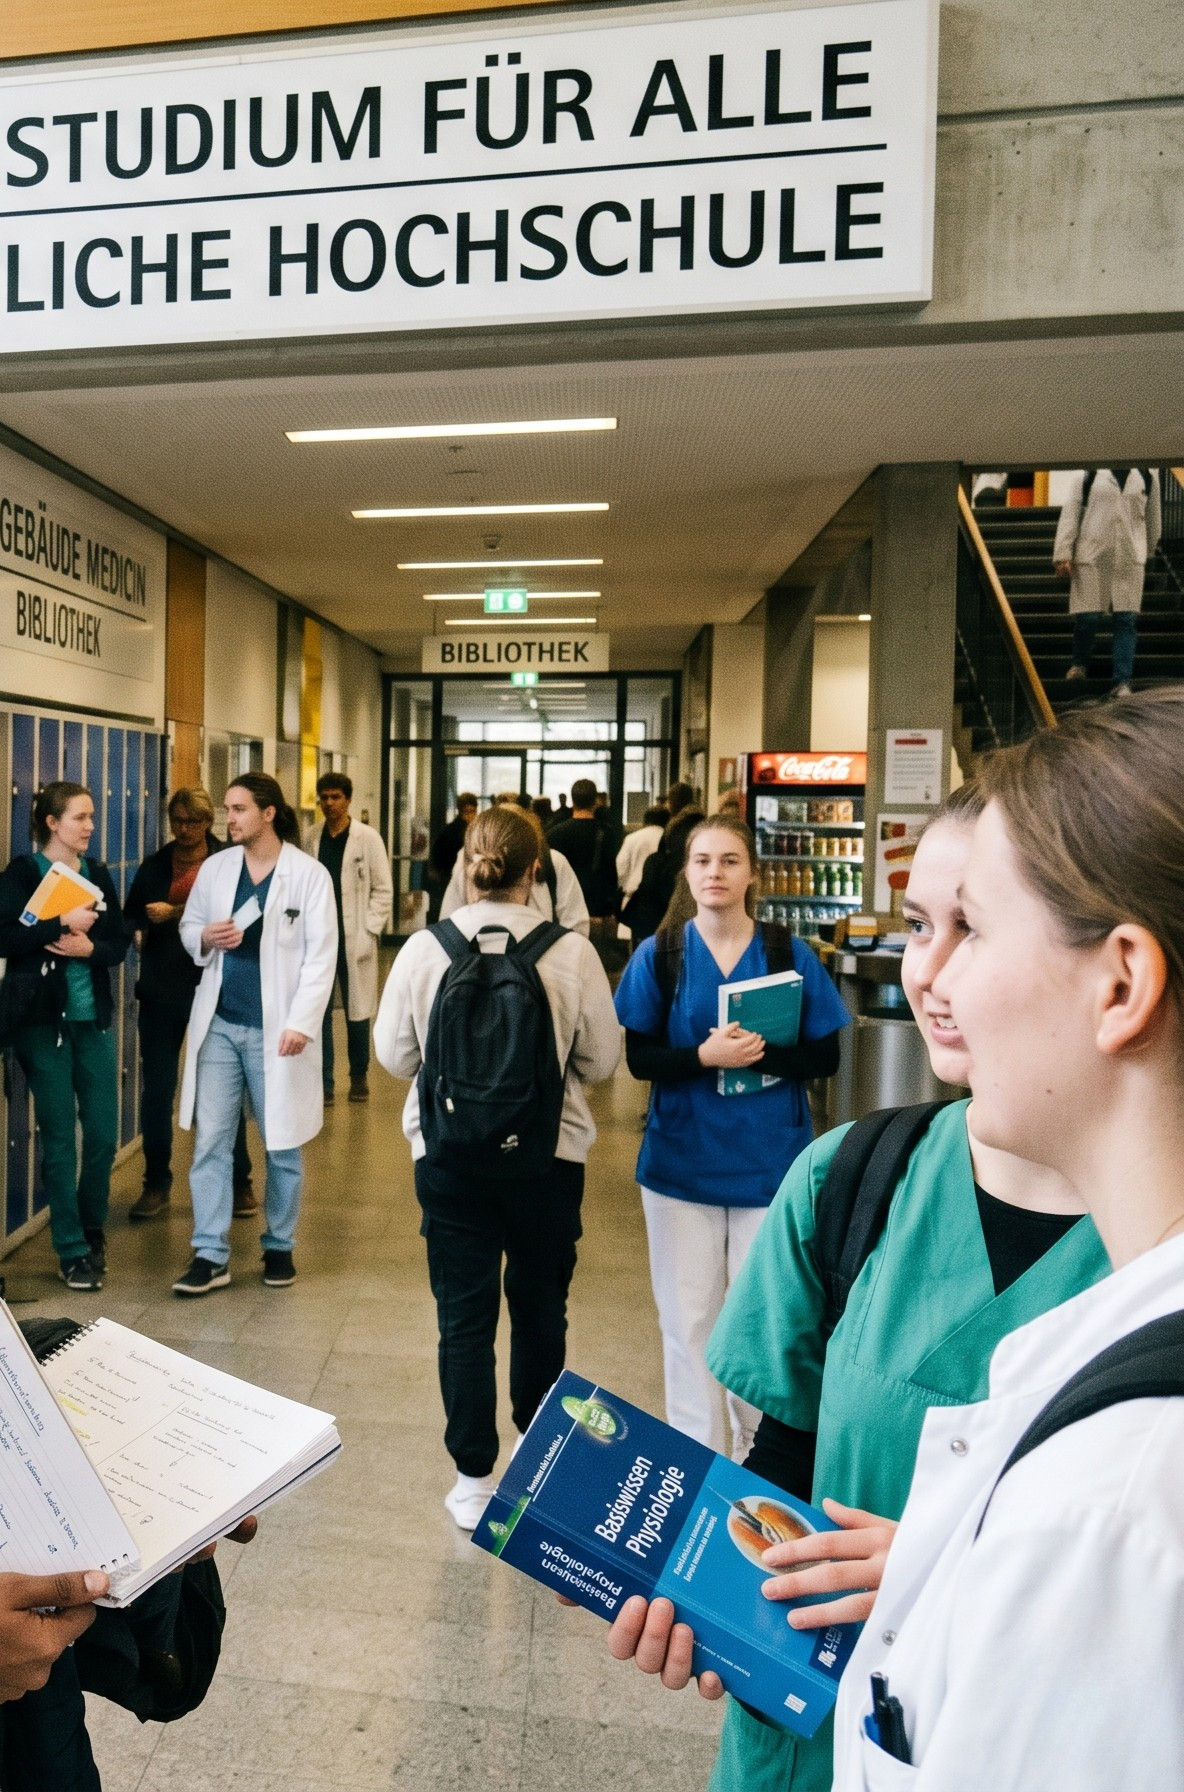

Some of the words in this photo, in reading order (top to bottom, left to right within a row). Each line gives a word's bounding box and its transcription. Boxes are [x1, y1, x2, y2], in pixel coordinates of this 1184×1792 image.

[6, 86, 381, 188] STUDIUM
[423, 52, 594, 154] FÜR
[629, 40, 872, 137] ALLE
[269, 182, 883, 297] HOCHSCHULE
[86, 539, 146, 606] MEDICIN
[16, 590, 101, 658] BIBLIOTHEK
[441, 641, 589, 663] BIBLIOTHEK
[594, 1455, 653, 1543] Basiswissen
[625, 1465, 685, 1558] Physiologie
